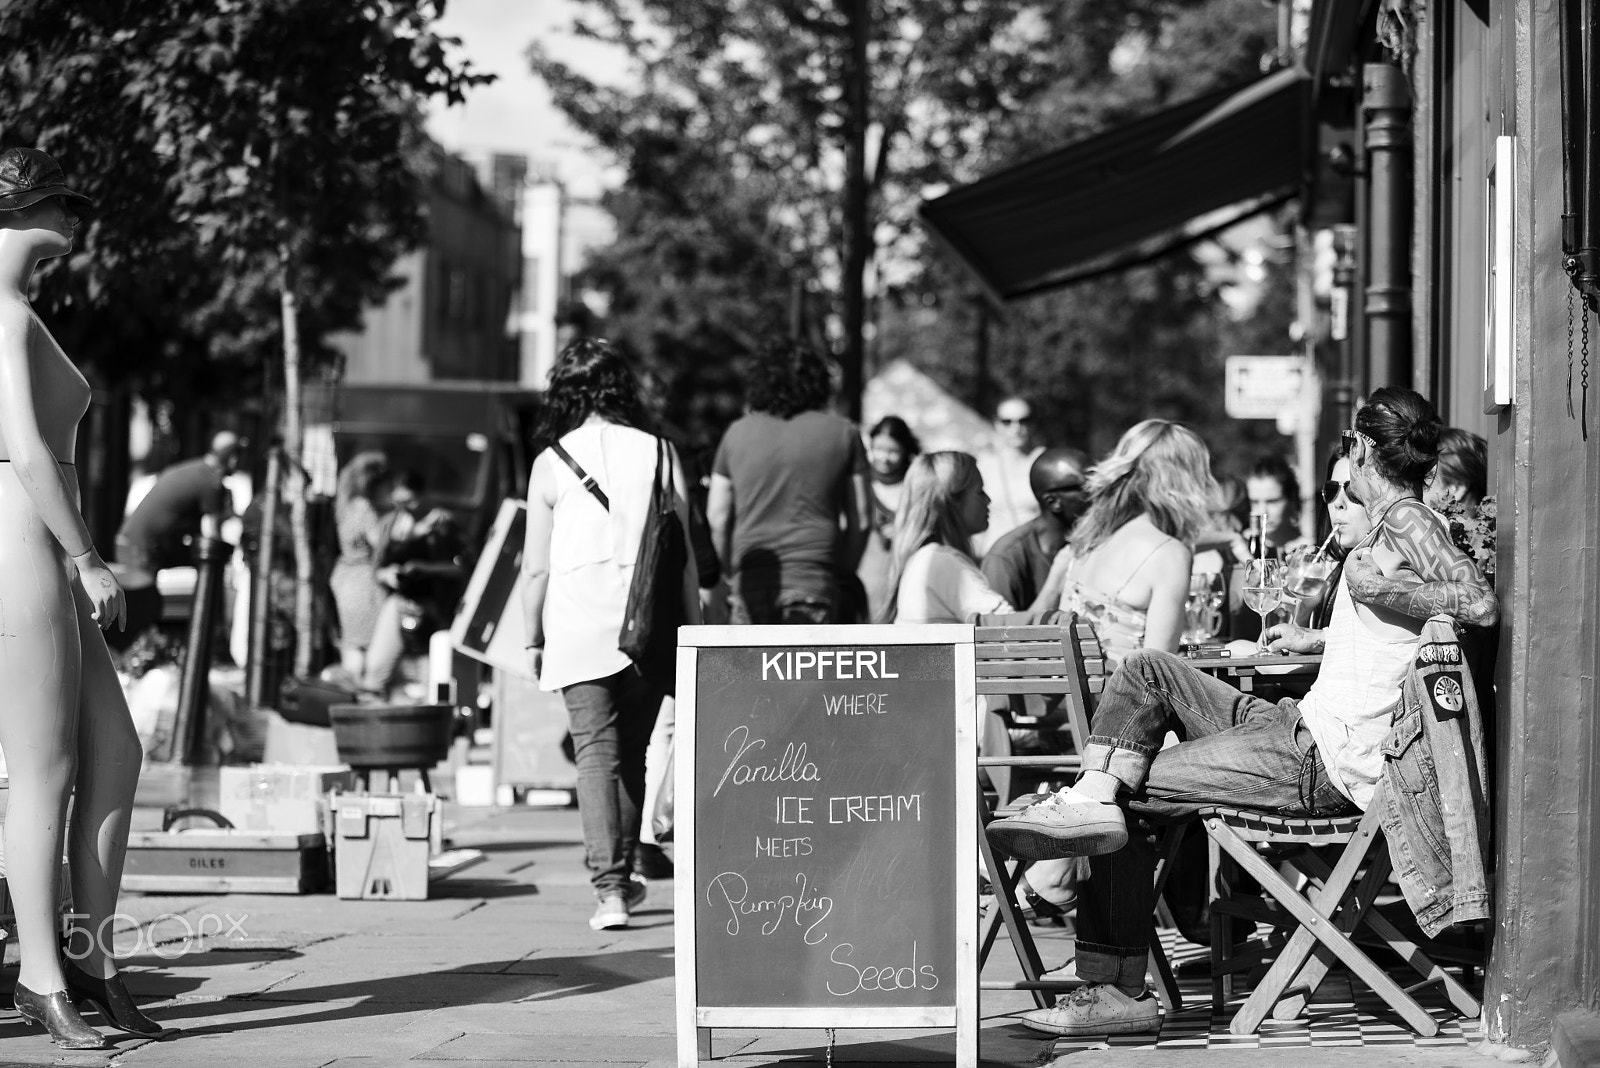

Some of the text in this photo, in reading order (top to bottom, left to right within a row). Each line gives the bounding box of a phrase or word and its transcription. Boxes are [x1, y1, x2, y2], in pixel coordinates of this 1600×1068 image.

[762, 651, 899, 680] KIPFERL
[823, 694, 889, 716] WHERE
[713, 725, 821, 797] Vanilla
[776, 794, 921, 824] ICE CREAM
[755, 836, 813, 858] MEETS
[189, 858, 225, 869] GILES
[706, 871, 833, 945] Pumpkin
[826, 940, 939, 996] Seeds
